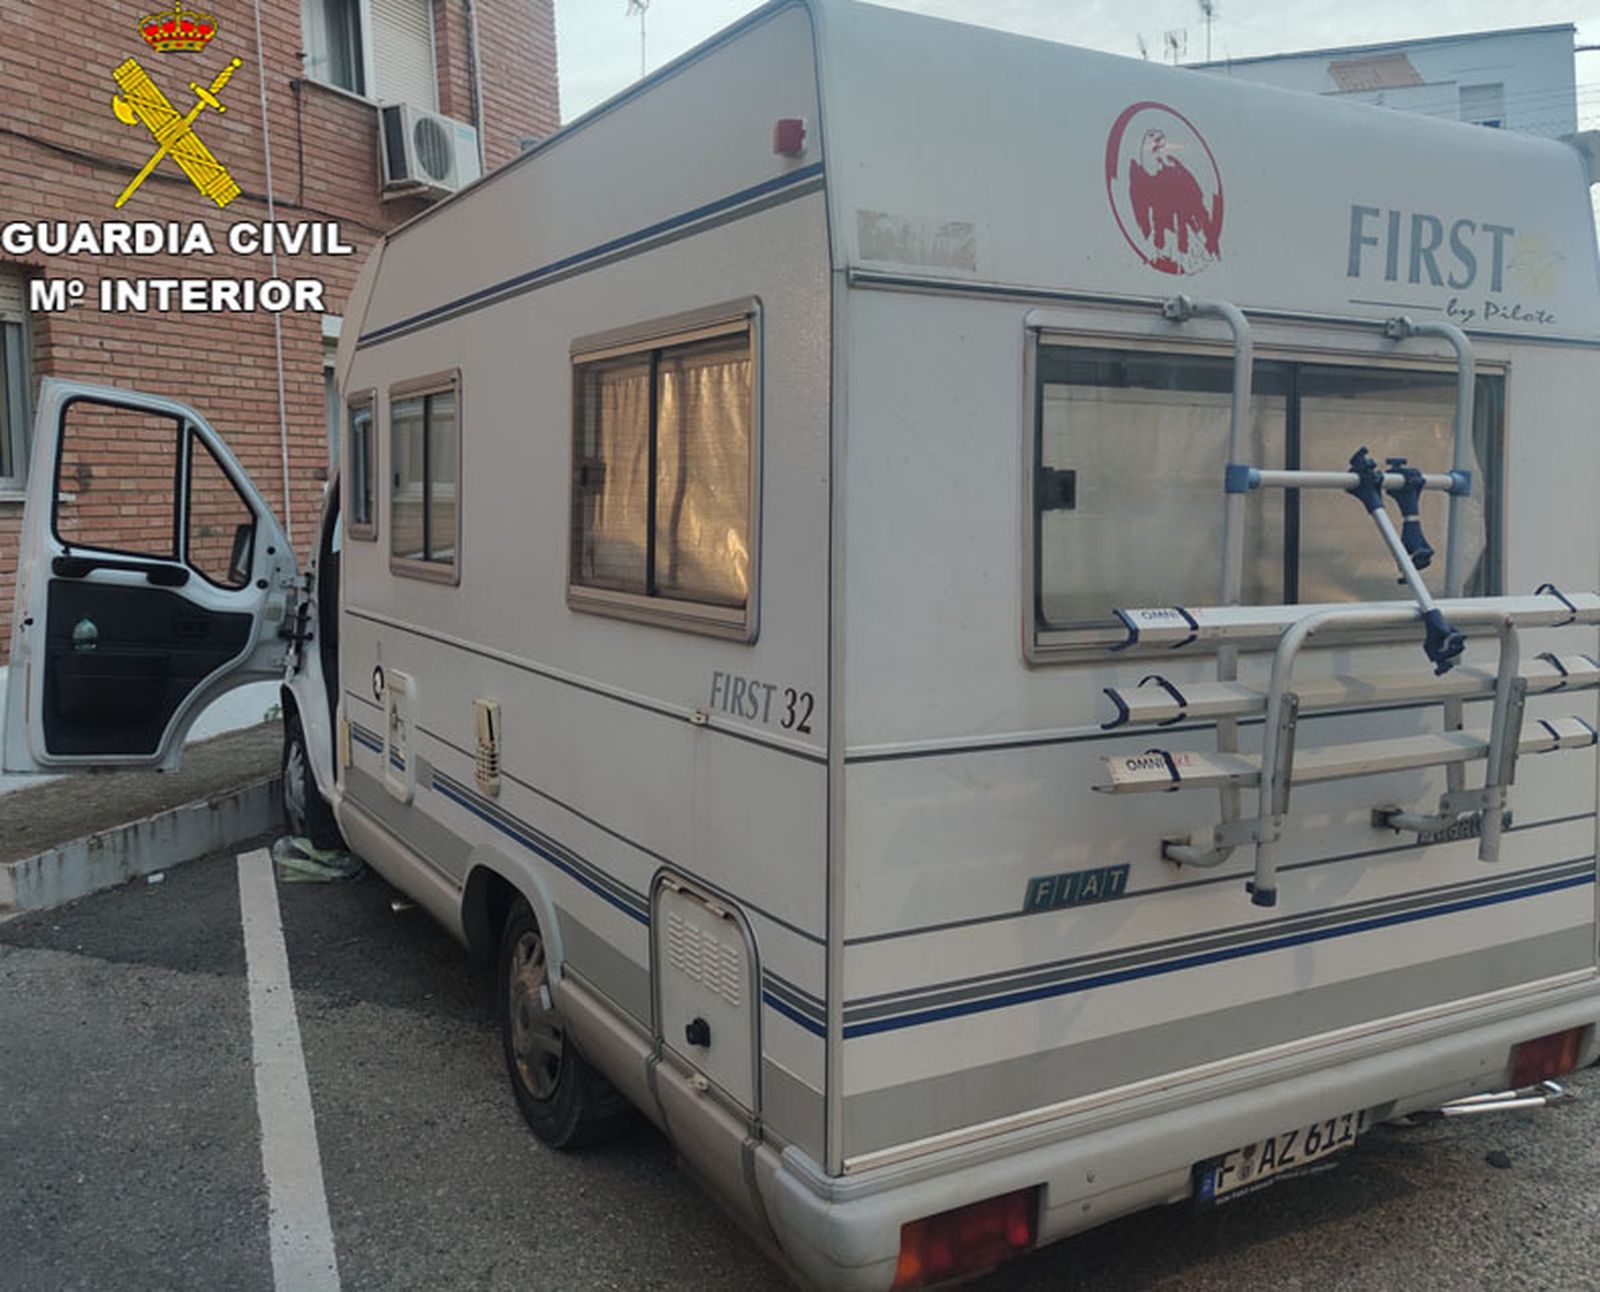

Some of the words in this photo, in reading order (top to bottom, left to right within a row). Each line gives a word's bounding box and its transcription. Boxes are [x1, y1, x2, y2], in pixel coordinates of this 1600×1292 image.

[1346, 204, 1515, 293] FIRST
[1446, 298, 1476, 323] by
[1483, 301, 1557, 325] Pilote
[710, 671, 777, 724] FIRST
[781, 687, 814, 735] 32
[1034, 869, 1124, 905] FIAT
[1217, 1149, 1240, 1188] F
[1258, 1130, 1299, 1174] AZ
